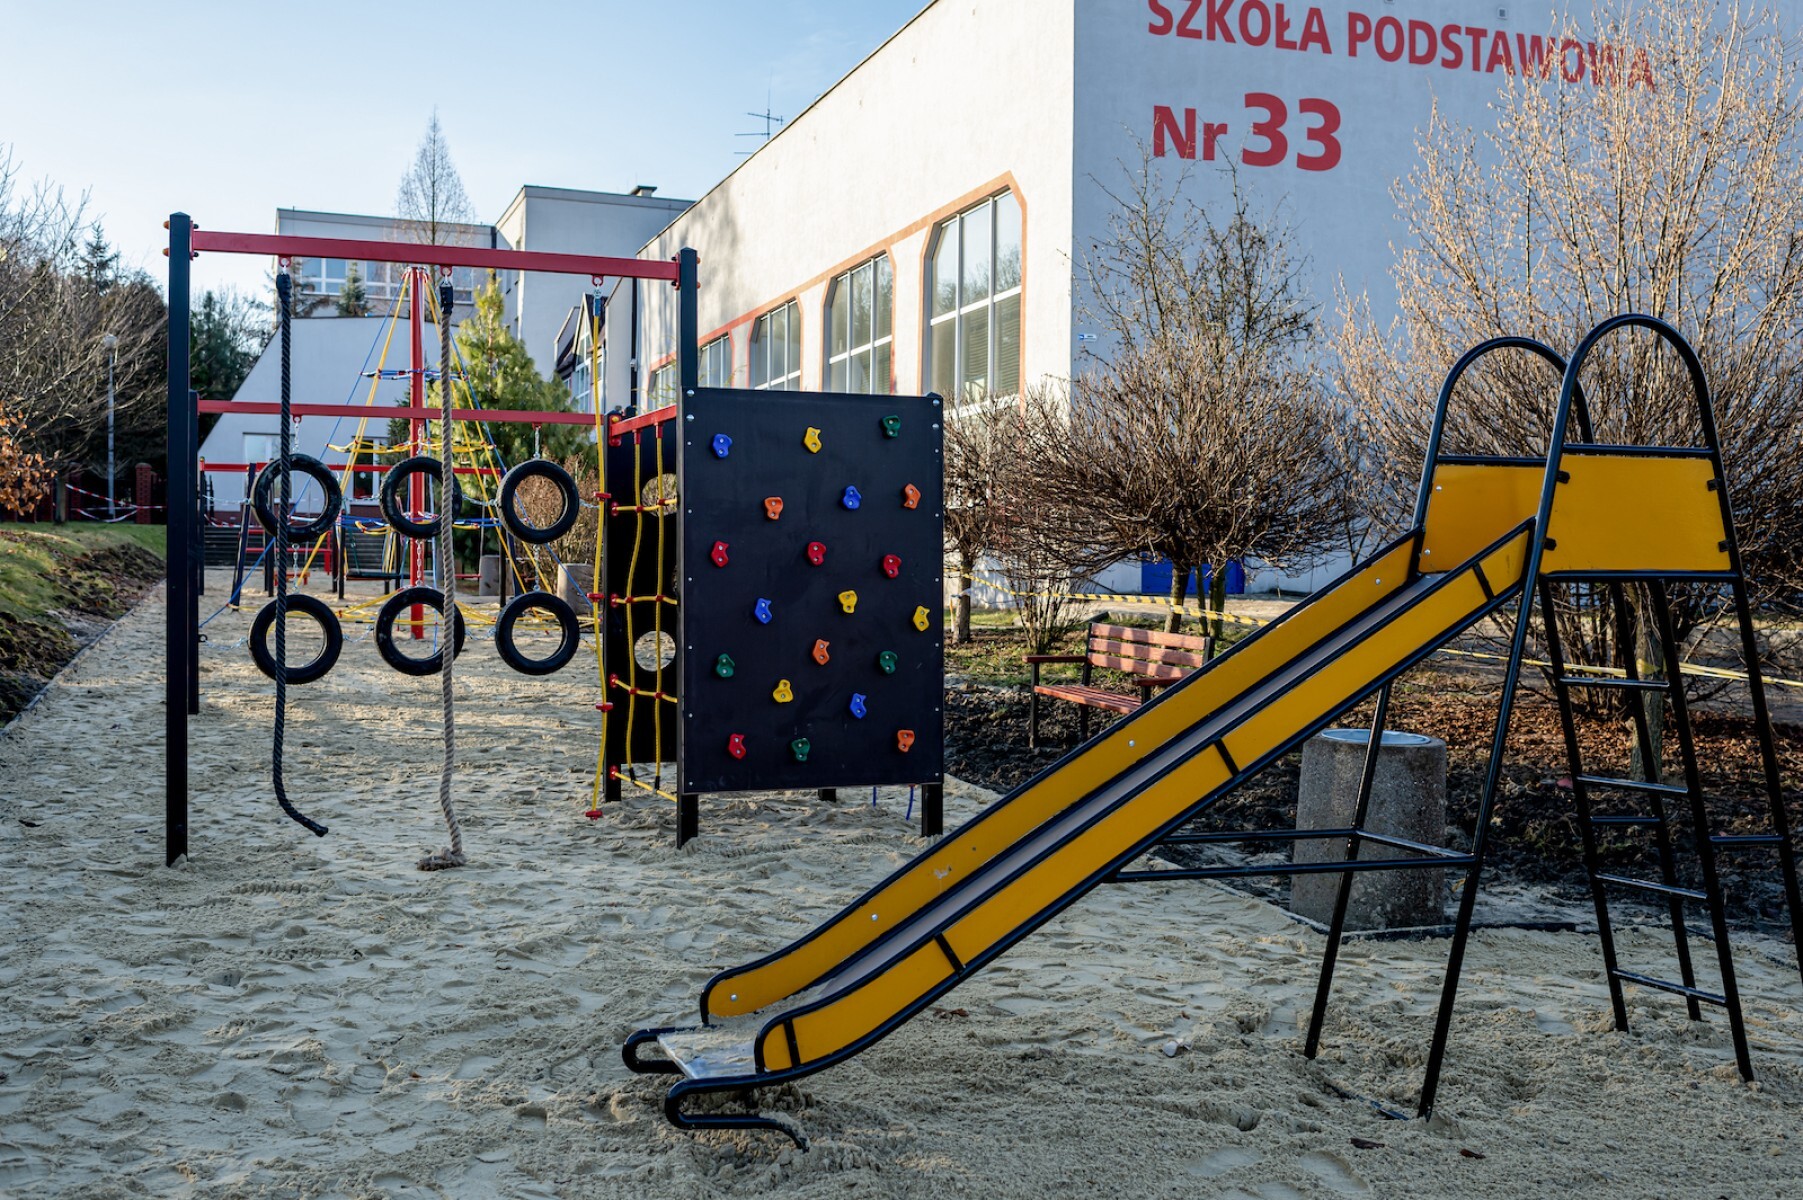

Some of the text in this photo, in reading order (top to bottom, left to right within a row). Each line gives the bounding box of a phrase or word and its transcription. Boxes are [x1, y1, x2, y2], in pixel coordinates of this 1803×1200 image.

[1148, 0, 1655, 92] SZKOŁA PODSTAWOWA
[1153, 92, 1342, 171] Nr 33
